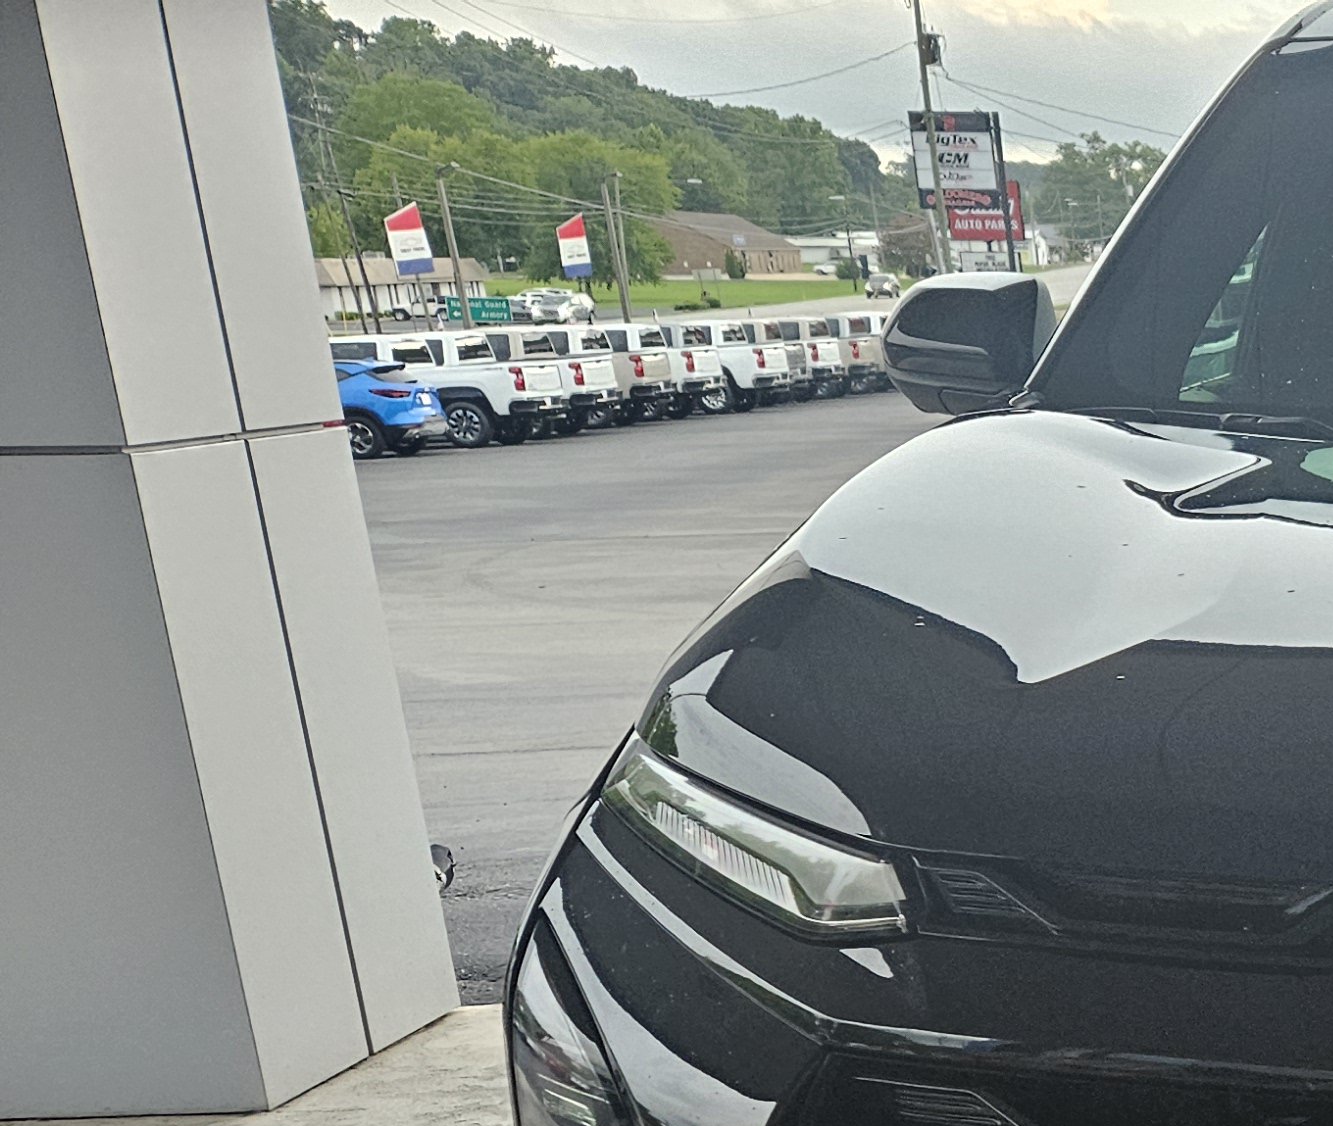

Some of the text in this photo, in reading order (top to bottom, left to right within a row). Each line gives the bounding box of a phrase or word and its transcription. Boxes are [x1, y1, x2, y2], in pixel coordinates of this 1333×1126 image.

[926, 134, 977, 147] igTex
[954, 218, 1018, 231] AUTO PARS
[450, 300, 507, 309] Nanal Guard
[481, 311, 508, 320] Armory
